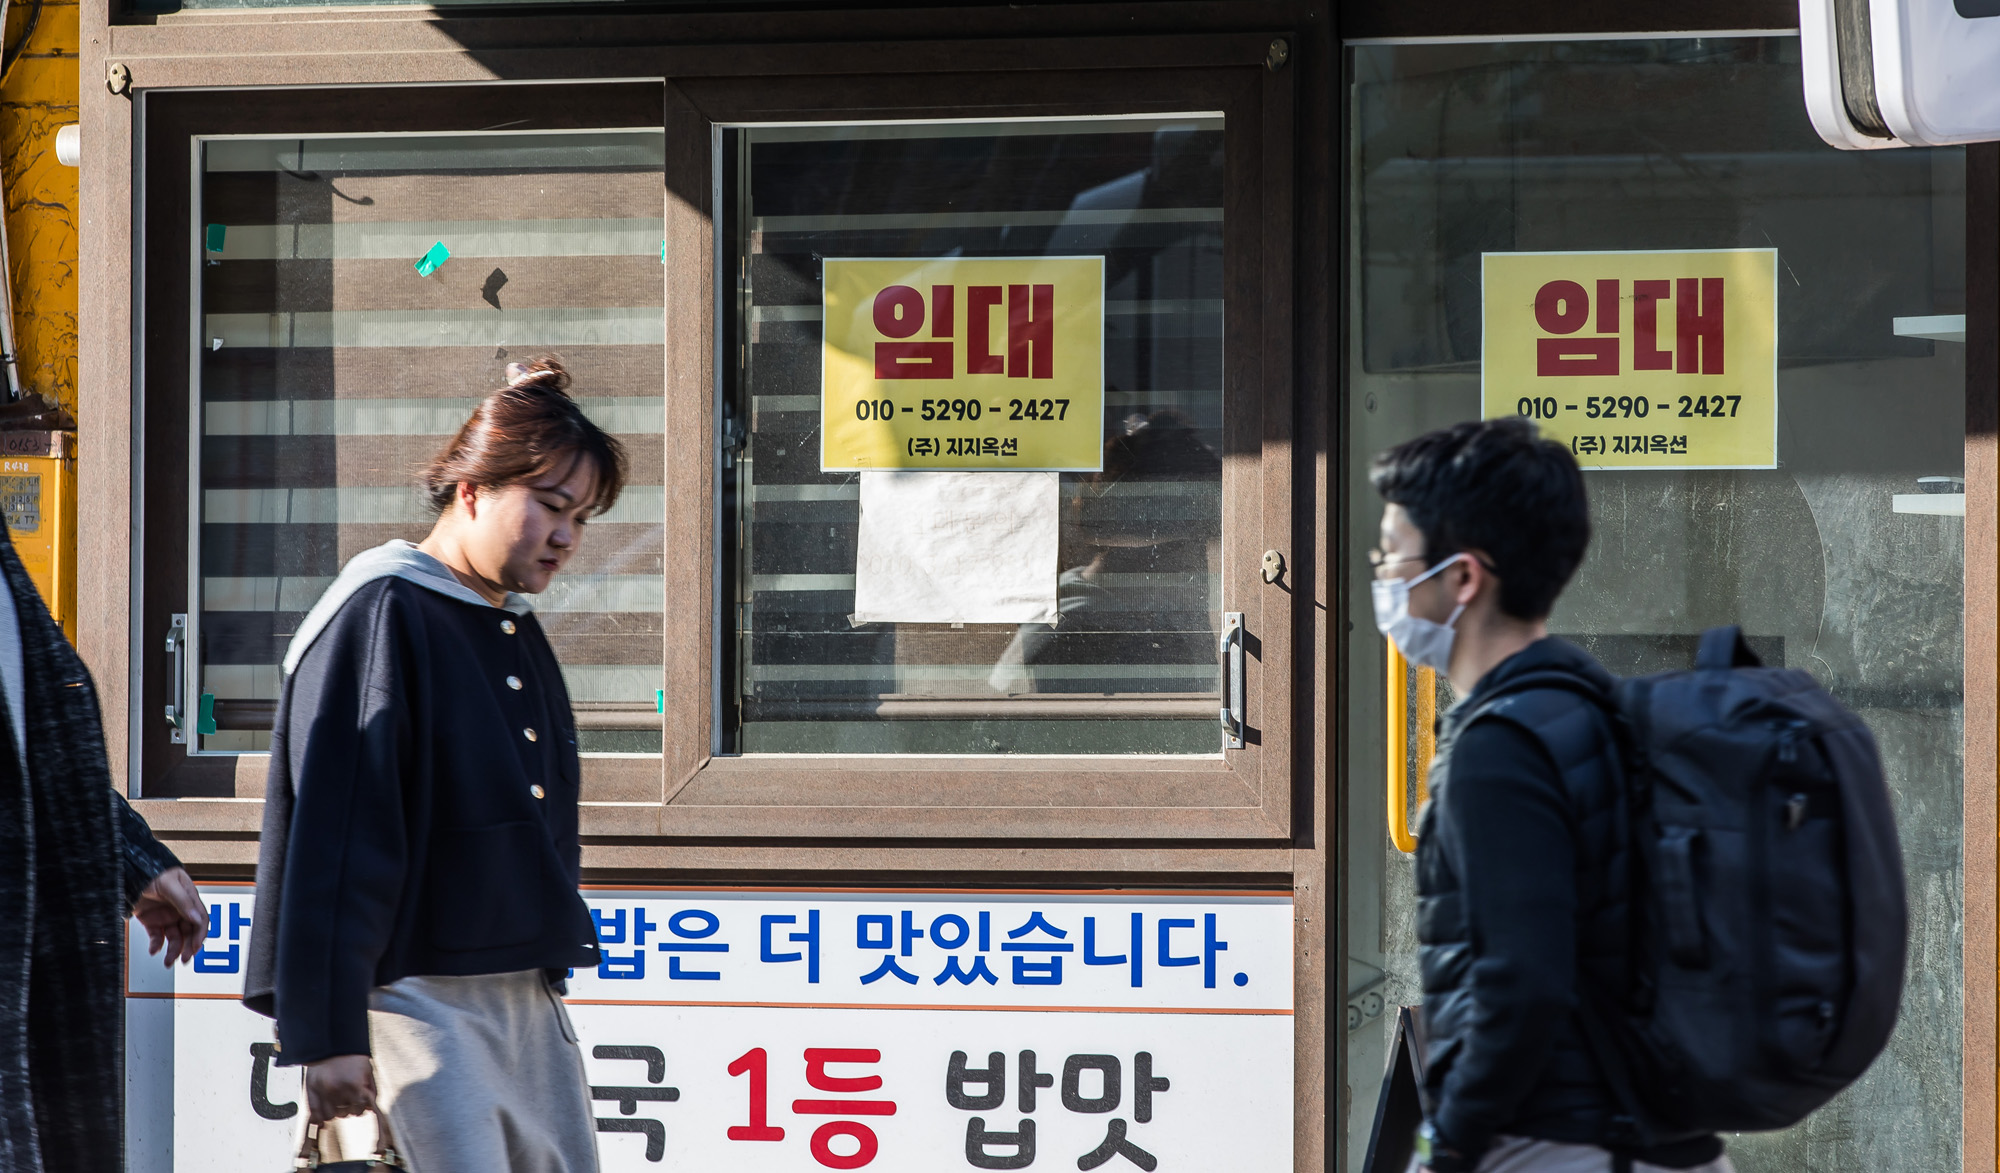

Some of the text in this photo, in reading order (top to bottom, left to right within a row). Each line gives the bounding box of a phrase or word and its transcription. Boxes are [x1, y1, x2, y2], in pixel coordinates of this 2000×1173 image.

[873, 285, 1053, 379] 임대
[1535, 278, 1724, 376] 임대
[856, 400, 894, 420] 010
[921, 399, 981, 421] 5290
[1009, 399, 1069, 420] 2427
[1517, 397, 1557, 419] 010
[1586, 396, 1649, 418] 5290
[1678, 396, 1741, 417] 2427
[908, 438, 1017, 456] (주) 지지옥션
[1572, 435, 1686, 455] (주) 지지옥션
[761, 910, 819, 983] 더
[857, 911, 1248, 988] 맛있습니다.
[728, 1048, 896, 1169] 1등
[947, 1050, 1169, 1171] 밥맛
